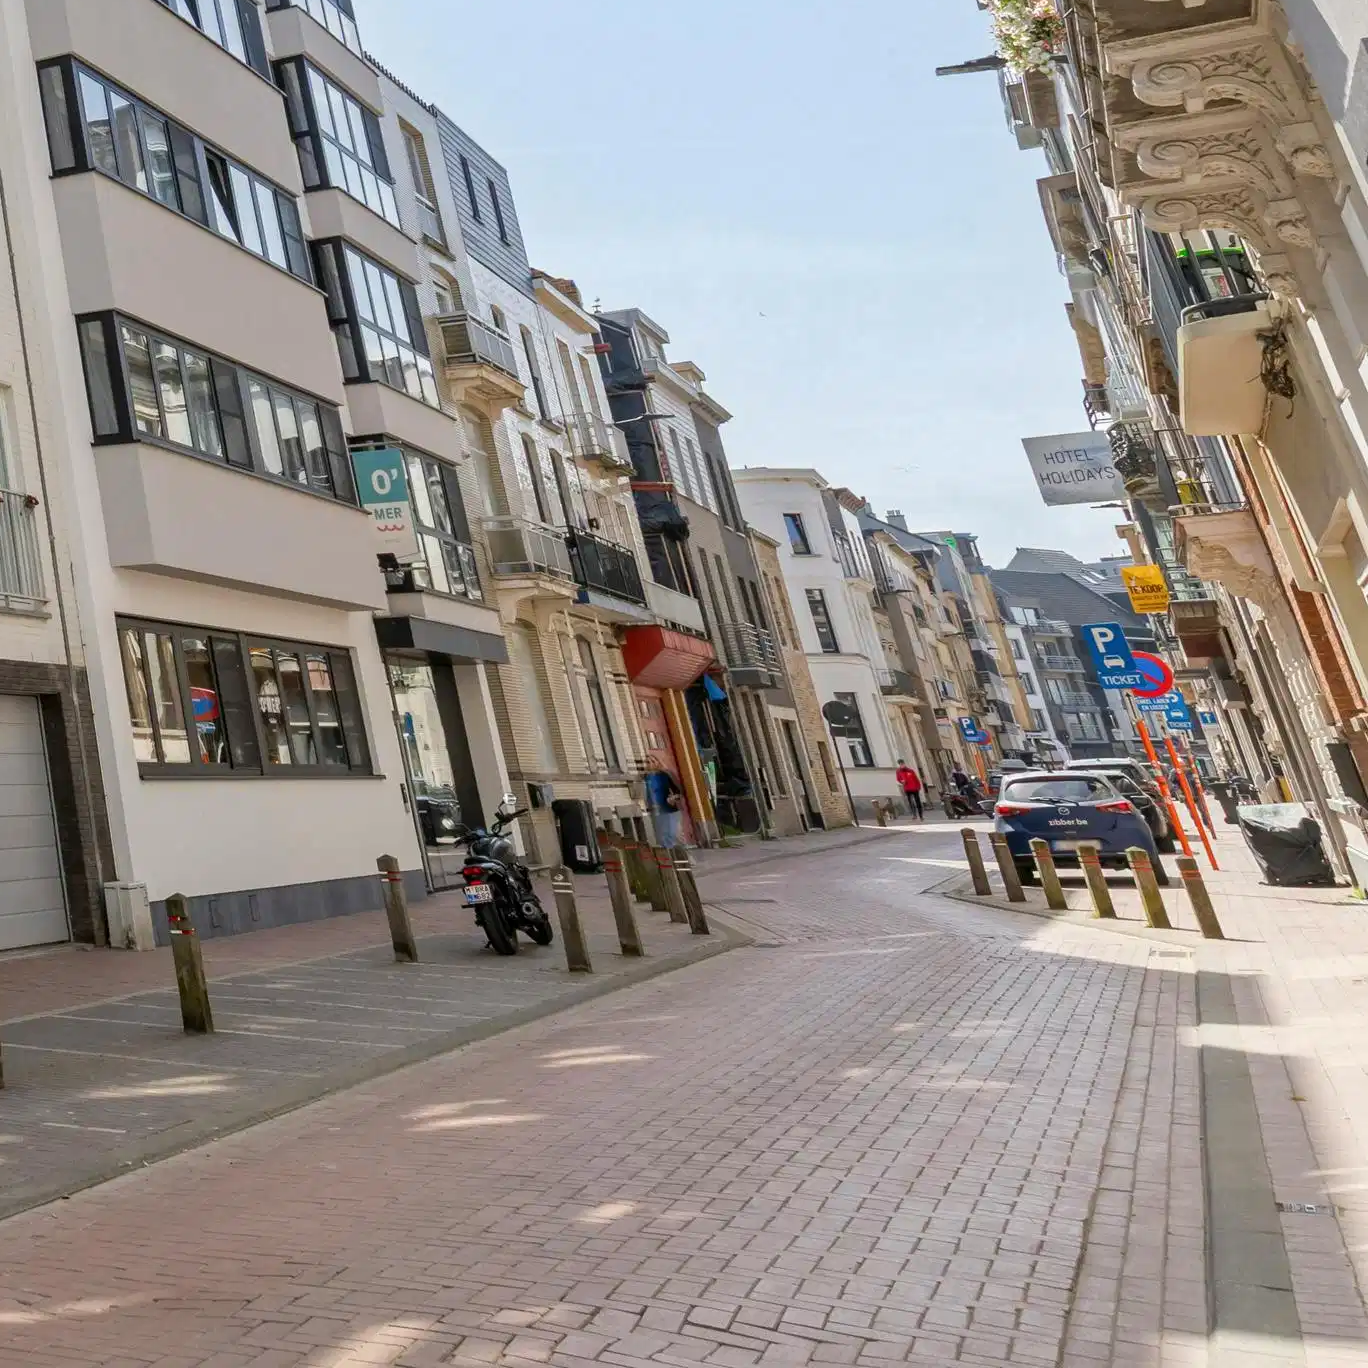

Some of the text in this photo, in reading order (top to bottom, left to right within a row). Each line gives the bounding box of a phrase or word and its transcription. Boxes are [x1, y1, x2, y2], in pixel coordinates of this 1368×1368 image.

[1044, 449, 1094, 464] HOTEL
[1040, 466, 1116, 485] HOLIDAYS
[374, 508, 402, 520] MER
[1090, 627, 1115, 653] P
[1102, 674, 1141, 685] TICKET
[961, 718, 970, 729] P
[1048, 818, 1088, 826] zibber.be
